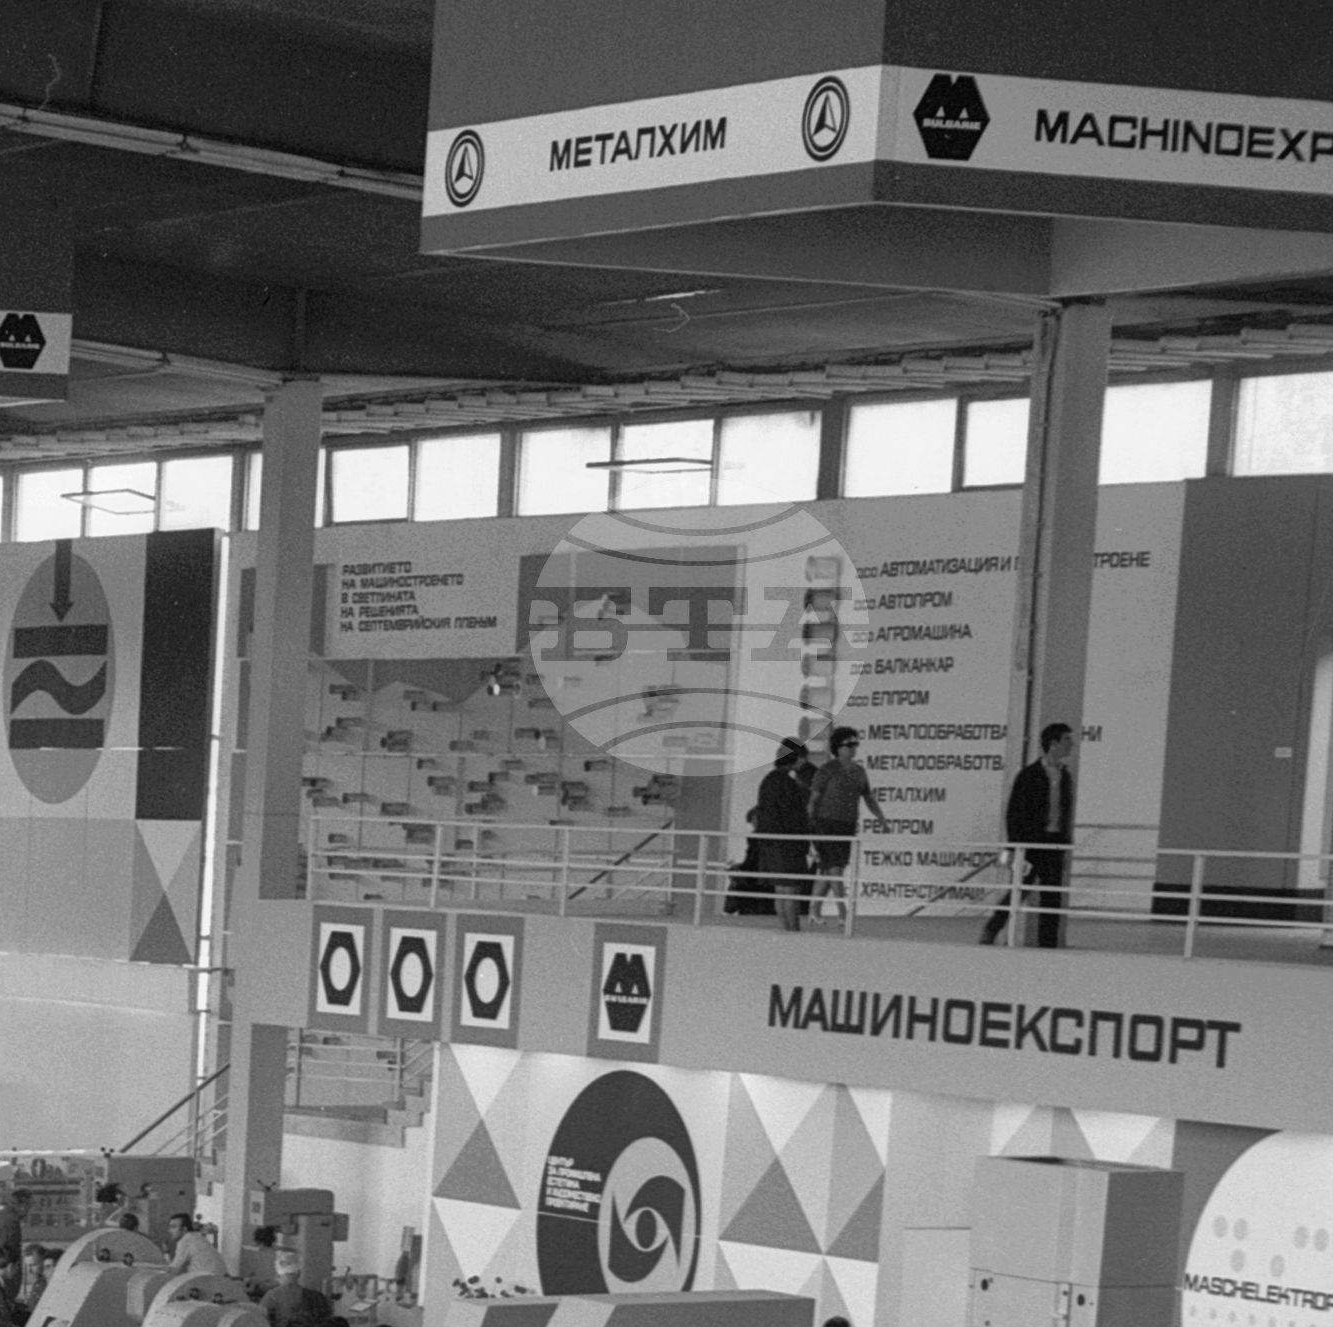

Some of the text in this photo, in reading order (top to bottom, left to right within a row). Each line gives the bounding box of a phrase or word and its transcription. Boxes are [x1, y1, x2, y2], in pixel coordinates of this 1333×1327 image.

[548, 116, 728, 172] МЕТАЛХИМ
[880, 556, 1001, 578] АВТОМАТИЗАЦИЯ
[878, 592, 953, 611] АВТОПРОМ
[876, 624, 973, 643] АГРОМАШИНА
[875, 656, 954, 675] БАЛКАНКАР
[868, 724, 1008, 741] МЕТАЛООБРАБОТВА
[866, 755, 1004, 771] МЕТАЛООБРАБОТВ
[767, 983, 1242, 1070] МАШИНОЕКСПОРТ
